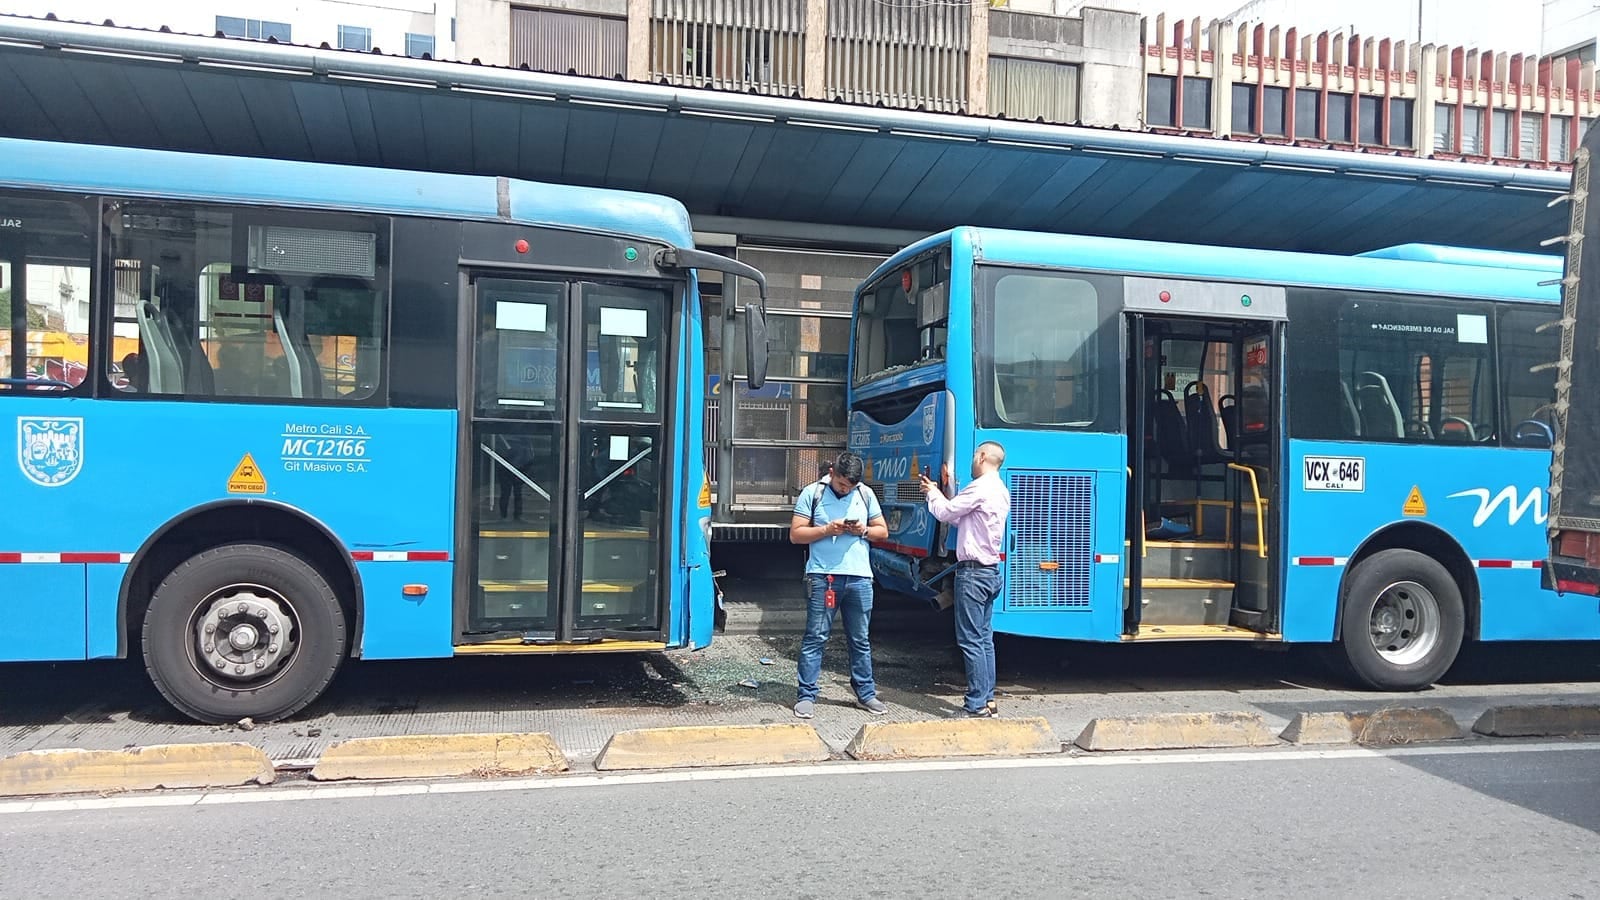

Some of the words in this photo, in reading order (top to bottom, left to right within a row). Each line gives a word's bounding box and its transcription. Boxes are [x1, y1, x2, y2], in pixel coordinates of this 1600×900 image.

[285, 423, 317, 434] Metro
[320, 424, 342, 434] Cali
[344, 425, 368, 435] S.A.
[281, 439, 366, 457] MC12166
[283, 461, 301, 472] Git
[303, 462, 342, 473] Masivo
[346, 463, 369, 473] S.A.
[1306, 461, 1330, 481] VCX
[1339, 461, 1360, 482] 646
